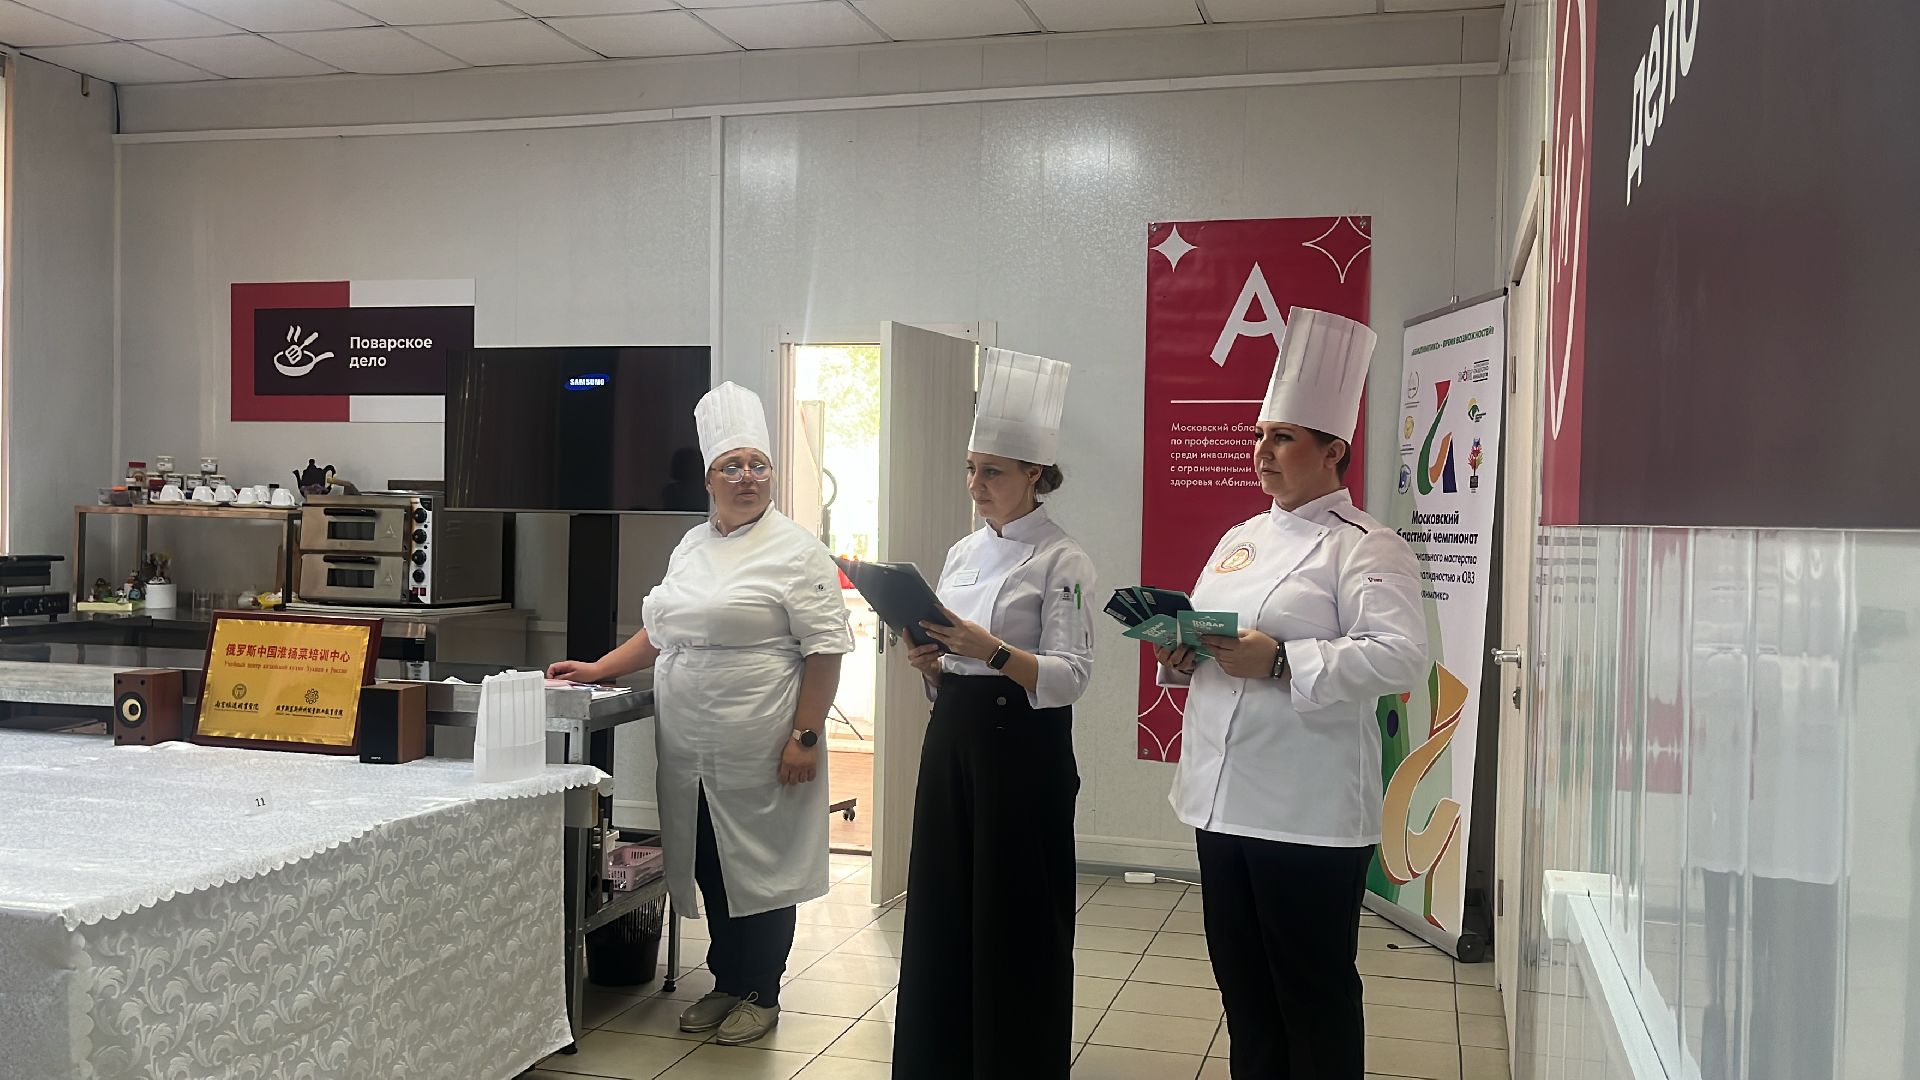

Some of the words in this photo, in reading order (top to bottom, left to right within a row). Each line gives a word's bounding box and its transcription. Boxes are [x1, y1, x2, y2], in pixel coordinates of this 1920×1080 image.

[349, 336, 433, 352] Поварское
[349, 356, 387, 369] дело
[1171, 423, 1229, 432] Московский
[1170, 452, 1198, 460] среди
[1200, 452, 1251, 460] инвалидов
[1177, 466, 1252, 474] ограниченными
[1170, 479, 1213, 488] здоровья
[1411, 510, 1459, 525] Московский
[1432, 533, 1479, 545] чемпионат
[1444, 554, 1477, 566] мастерства
[1420, 571, 1456, 583] алидностью
[1461, 570, 1476, 585] ОВЗ
[226, 644, 350, 662] 俄罗斯中国淮扬菜培训中心
